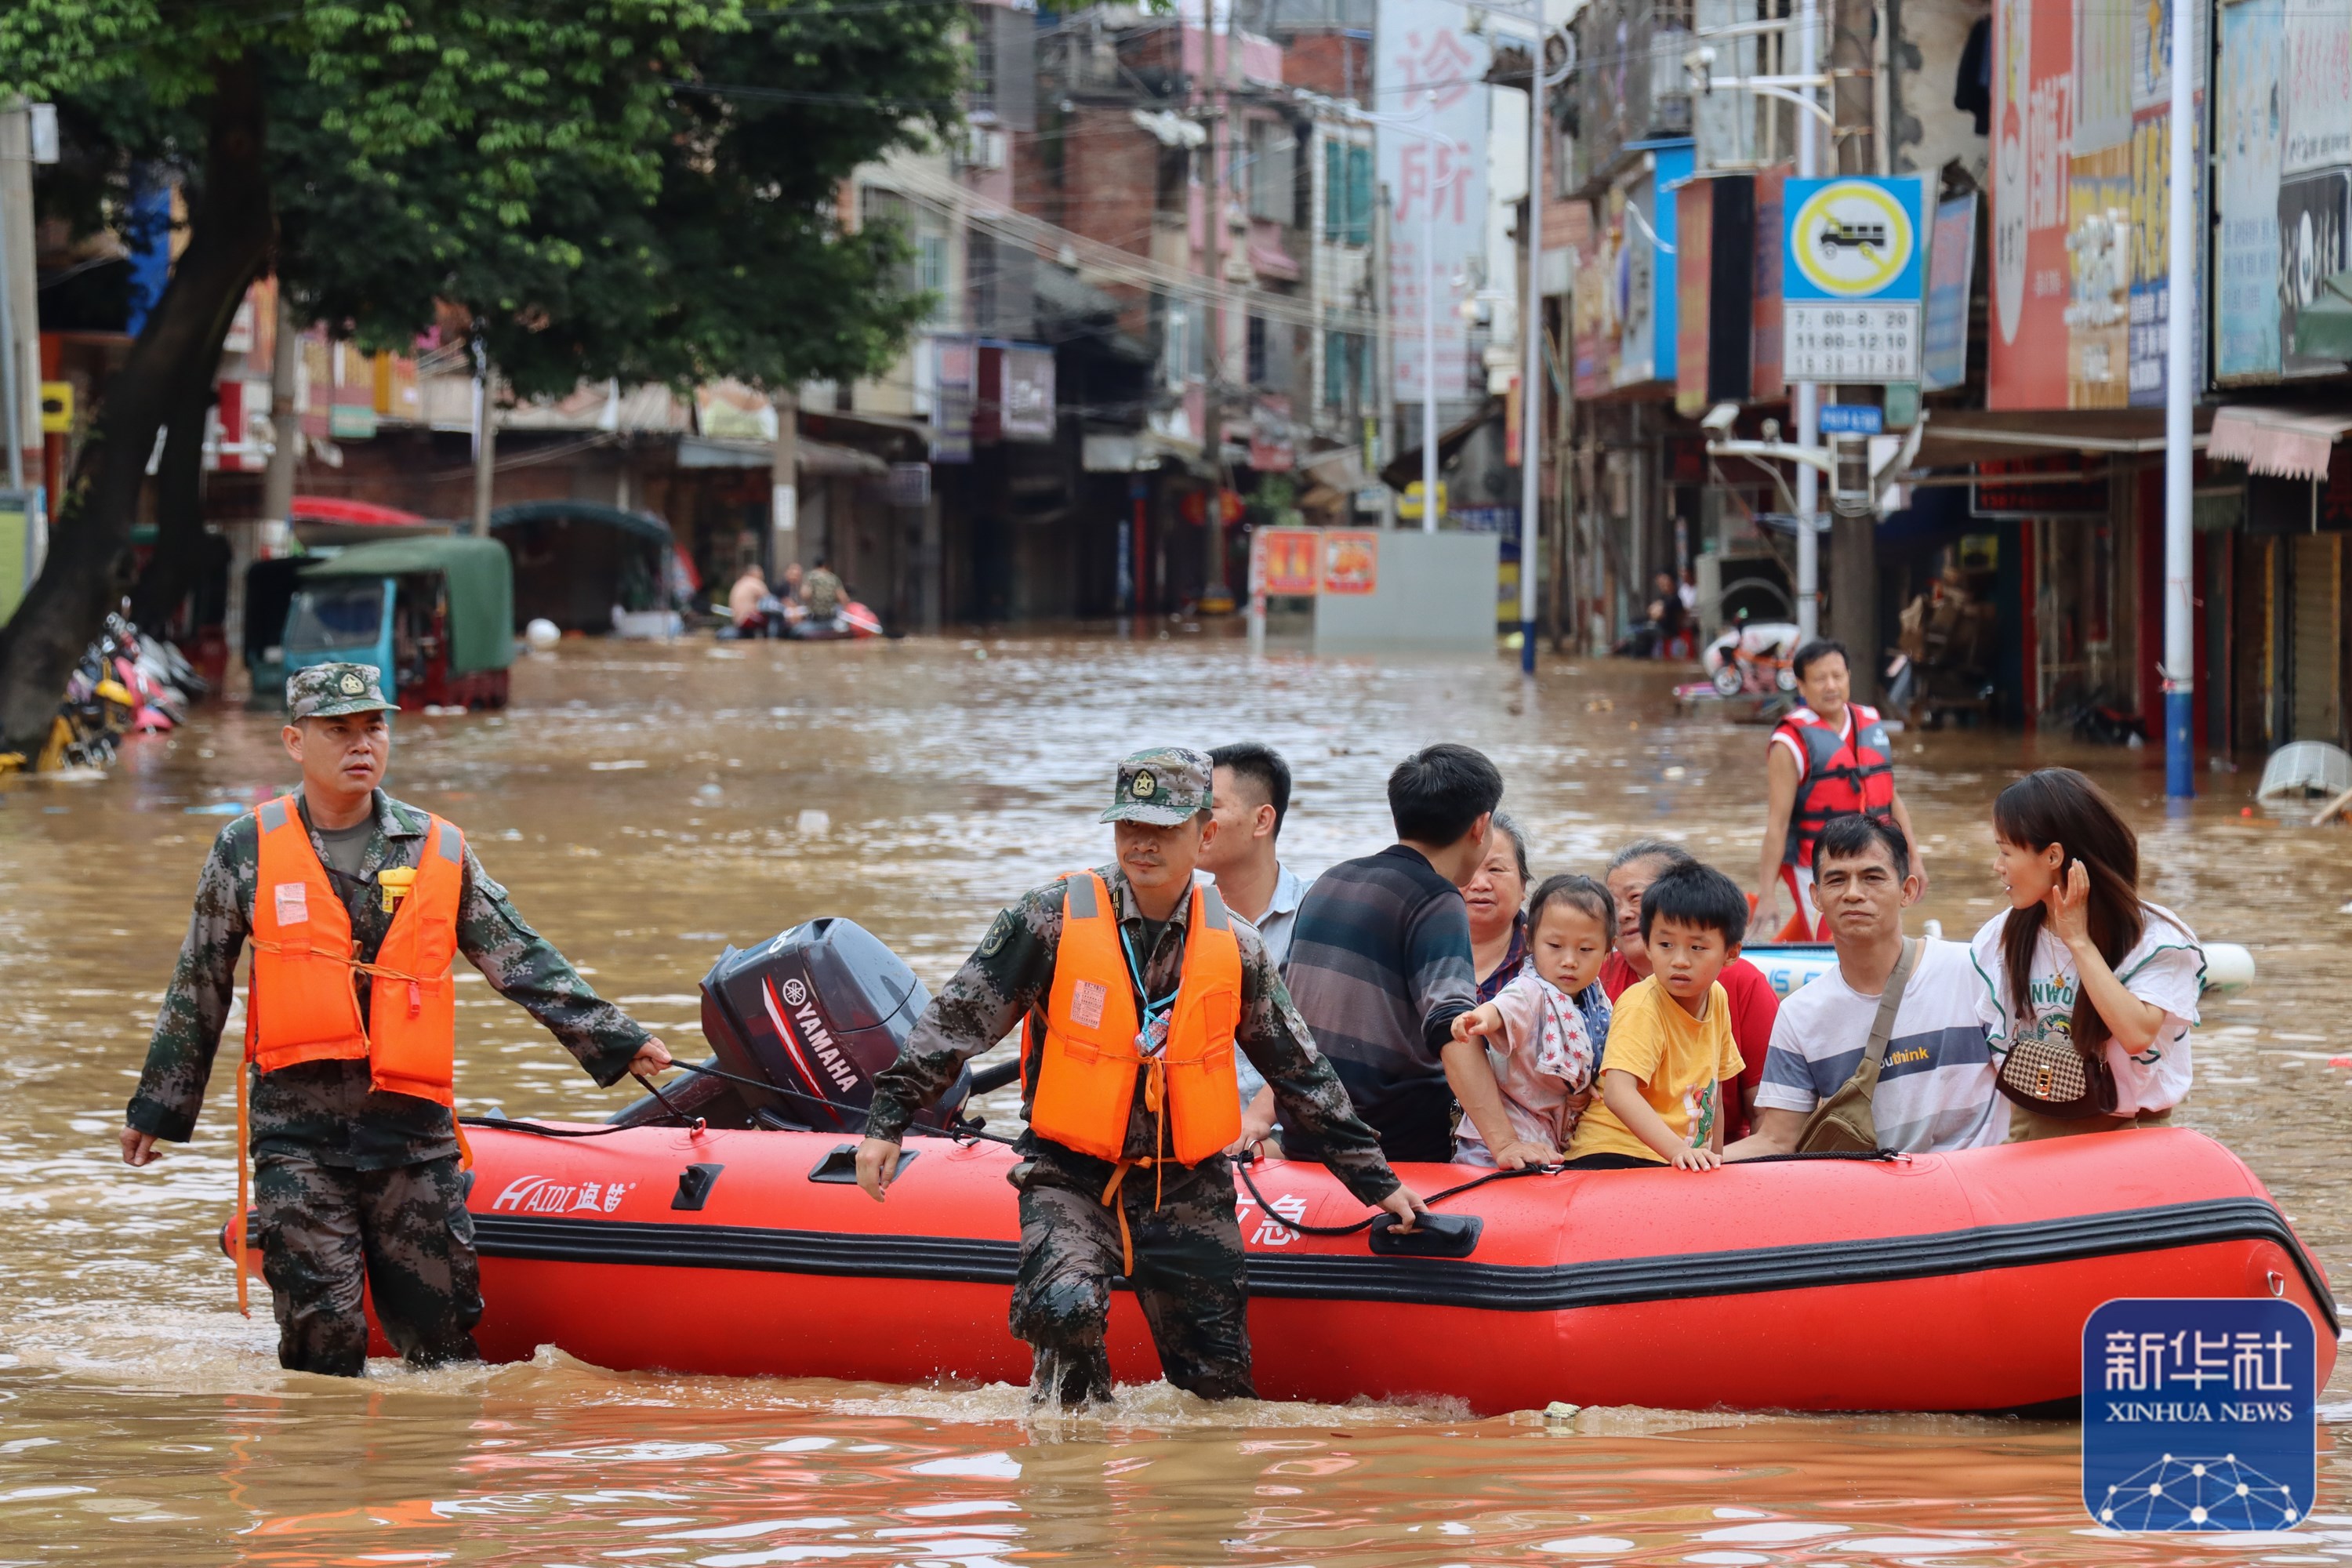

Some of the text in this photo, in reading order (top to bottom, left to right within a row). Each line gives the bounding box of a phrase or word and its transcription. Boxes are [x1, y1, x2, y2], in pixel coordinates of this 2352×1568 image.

[1396, 28, 1473, 223] 诊所
[794, 1000, 859, 1093] YAMAHA
[492, 1175, 626, 1213] HAIDI 海笛
